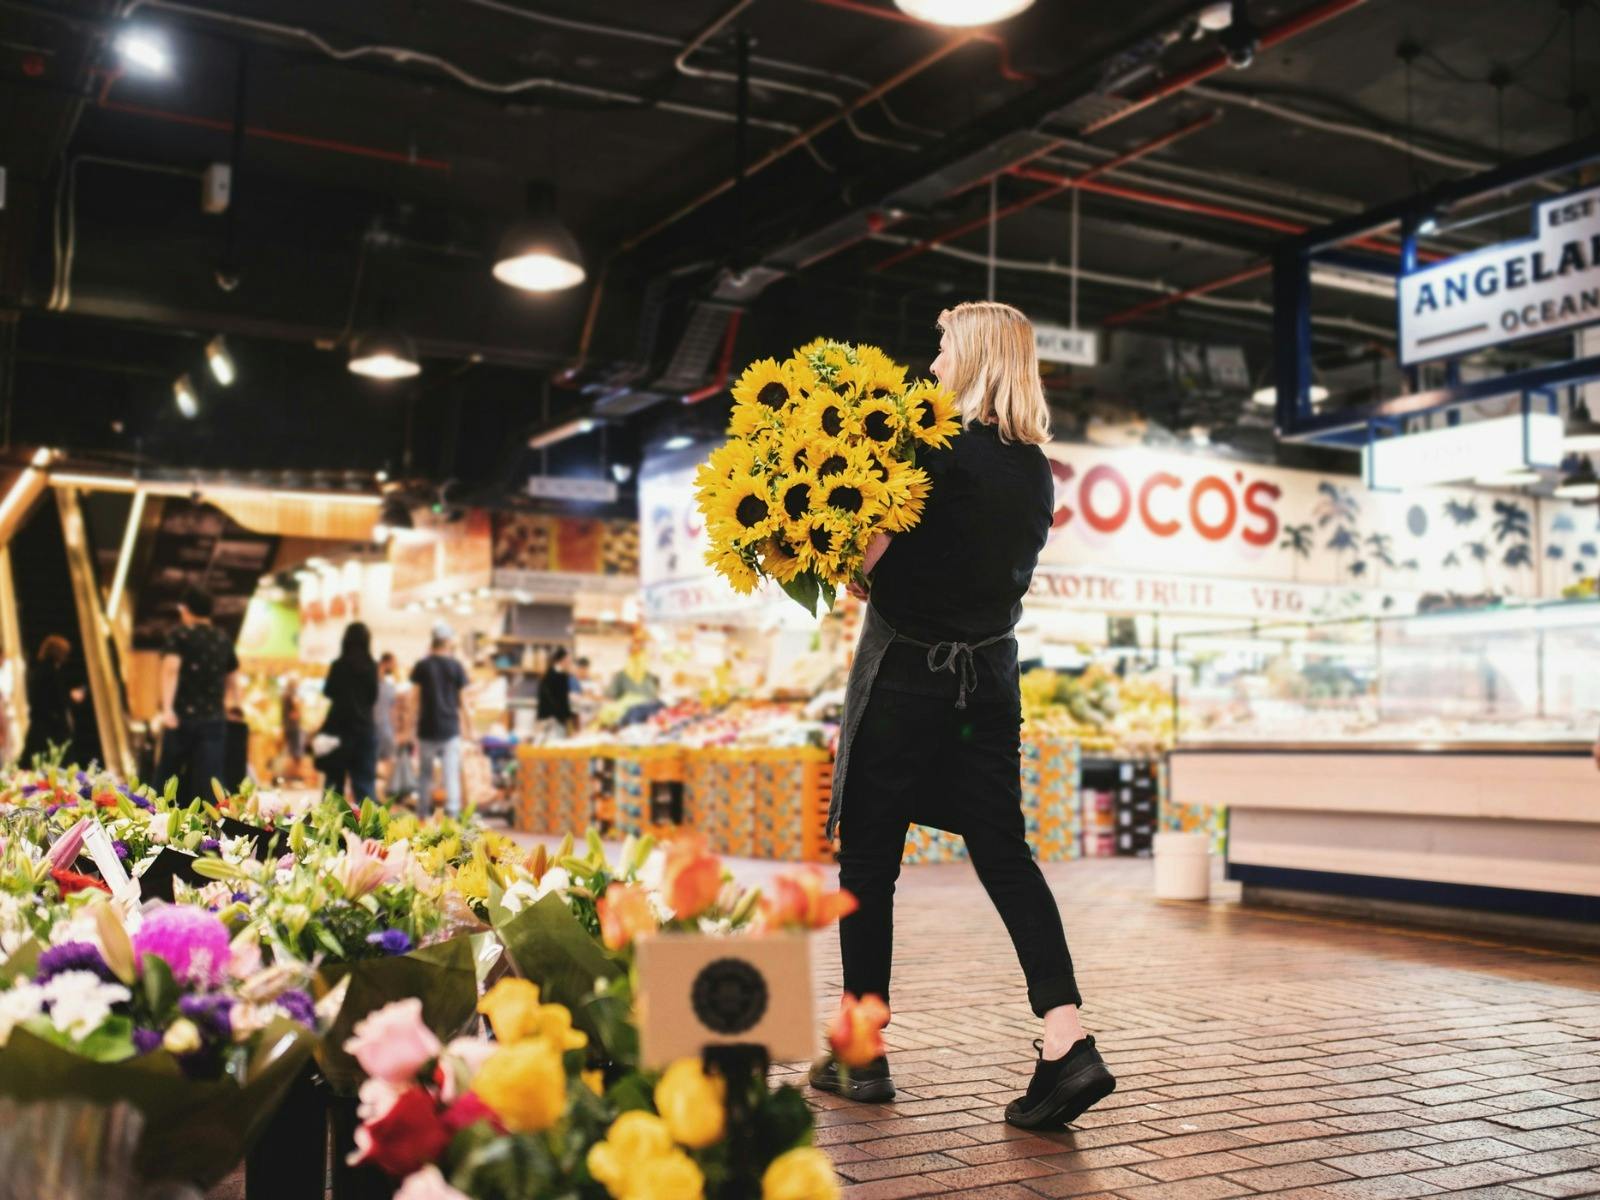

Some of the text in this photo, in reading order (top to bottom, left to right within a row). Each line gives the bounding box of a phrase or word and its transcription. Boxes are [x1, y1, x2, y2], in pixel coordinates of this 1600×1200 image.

[1549, 200, 1592, 227] EST
[1501, 289, 1600, 333] OCEAN
[1135, 577, 1214, 607] FRUIT
[1252, 586, 1304, 612] VEG
